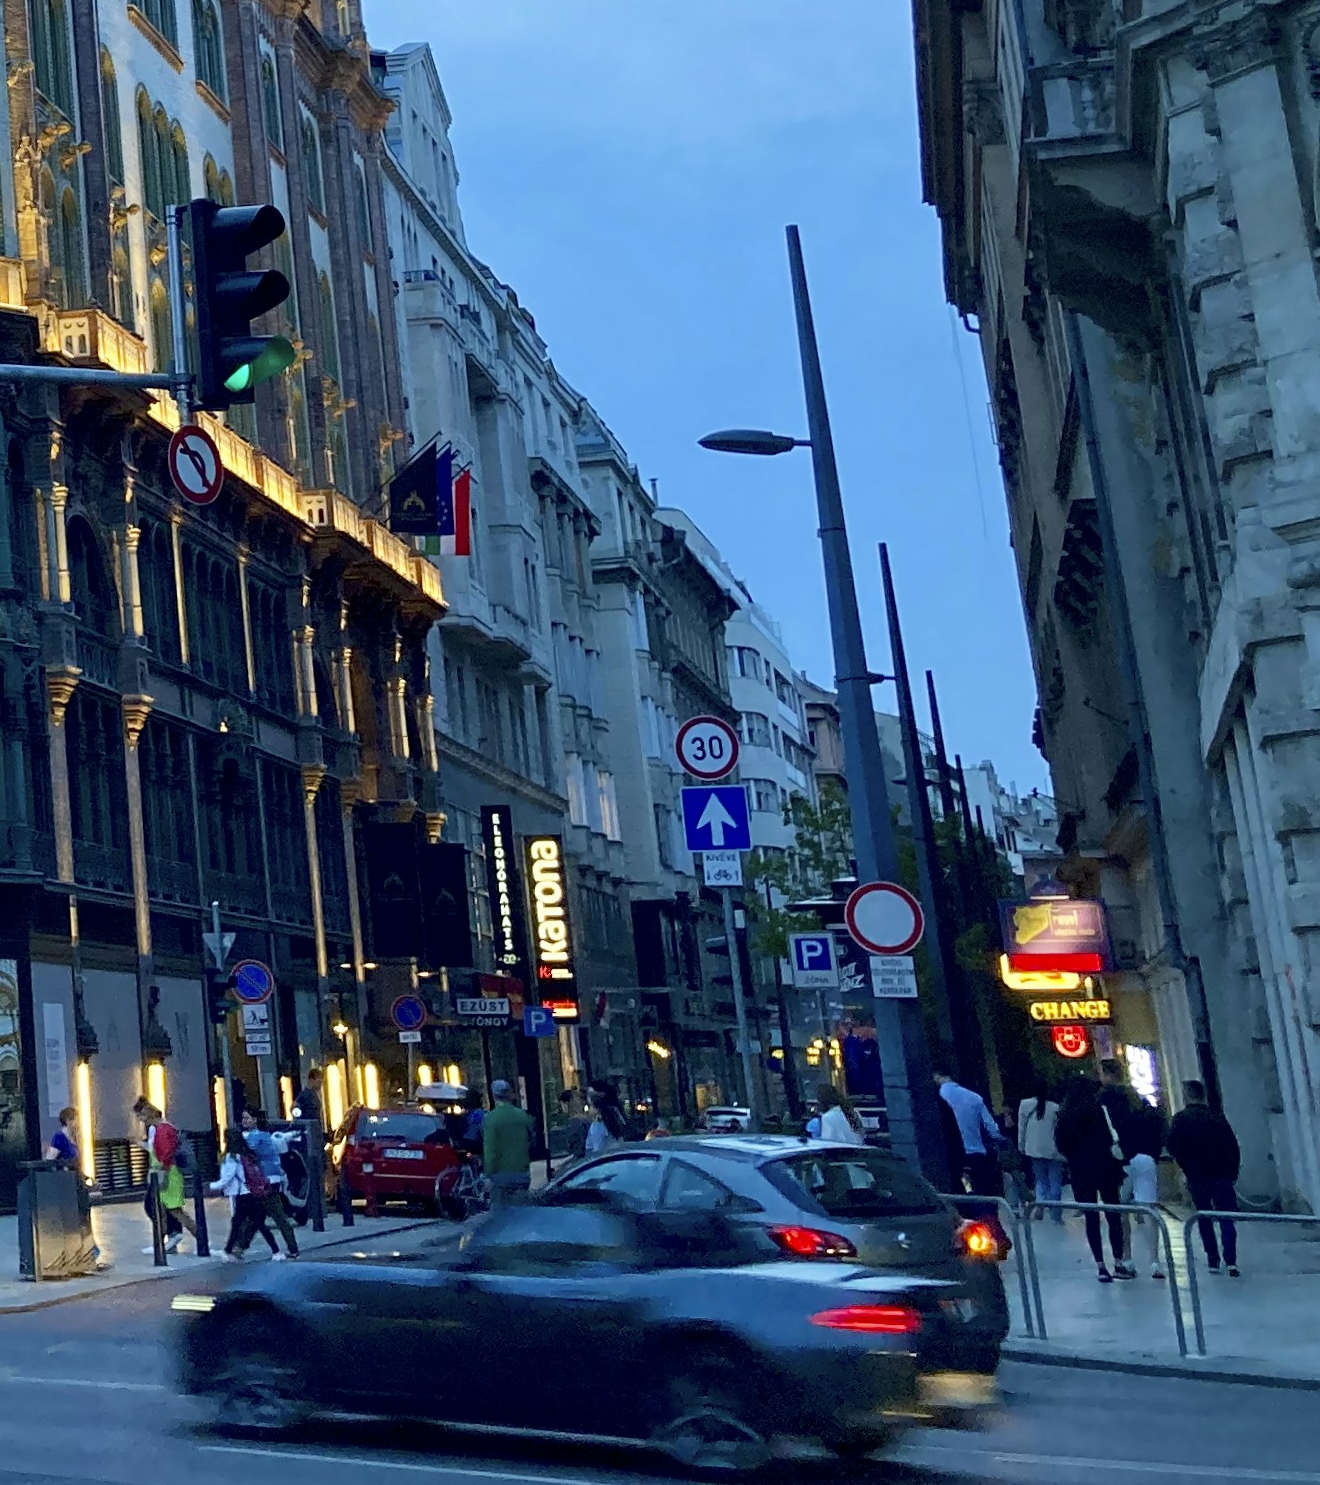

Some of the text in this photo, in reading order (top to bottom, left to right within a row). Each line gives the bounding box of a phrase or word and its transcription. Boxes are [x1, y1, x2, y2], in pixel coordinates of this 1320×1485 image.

[691, 736, 724, 761] 30
[800, 940, 823, 969] P
[531, 1010, 547, 1033] P
[1029, 1000, 1111, 1021] CHANGE
